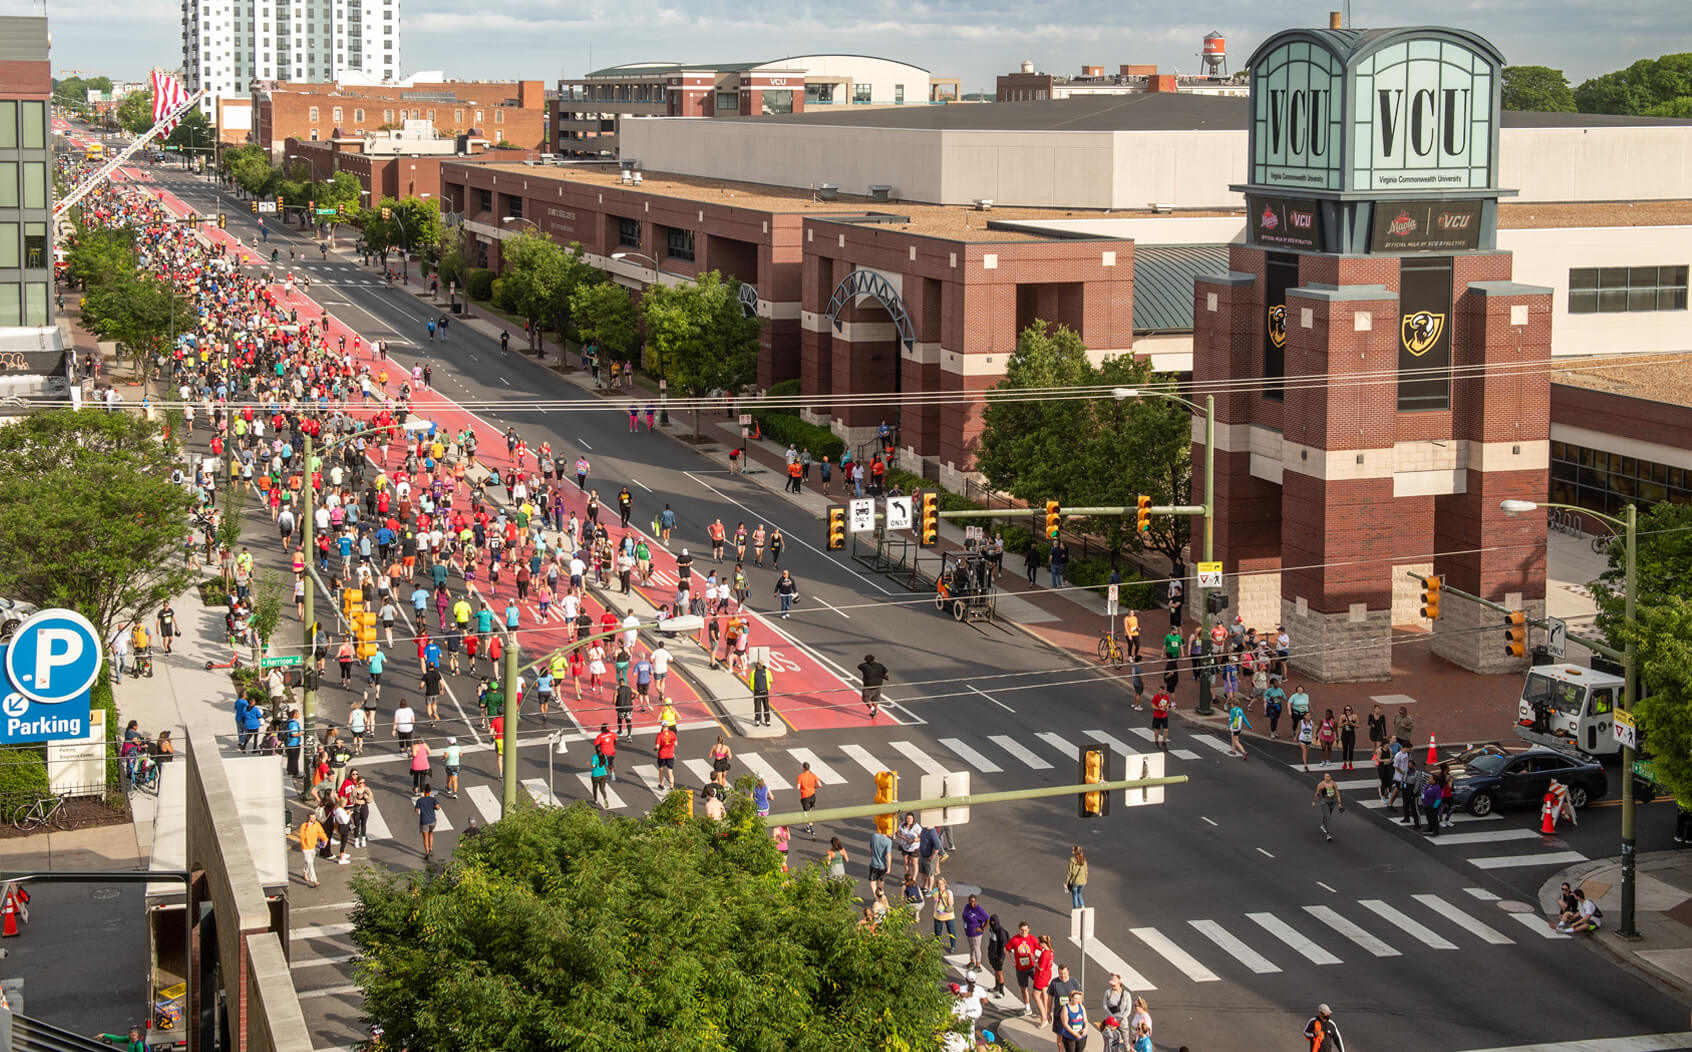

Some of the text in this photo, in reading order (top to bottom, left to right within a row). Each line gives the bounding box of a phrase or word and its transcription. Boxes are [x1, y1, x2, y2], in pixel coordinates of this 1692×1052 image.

[770, 78, 786, 86] VCU
[1270, 89, 1329, 157] VCU
[1377, 88, 1470, 158] VCU
[1379, 173, 1462, 185] Virginia Commonwealth University
[1293, 212, 1312, 227] VCU
[1443, 213, 1471, 228] VCU
[890, 519, 909, 527] ONLY
[35, 628, 83, 689] P
[267, 658, 293, 666] Harrison
[8, 715, 81, 736] Parking
